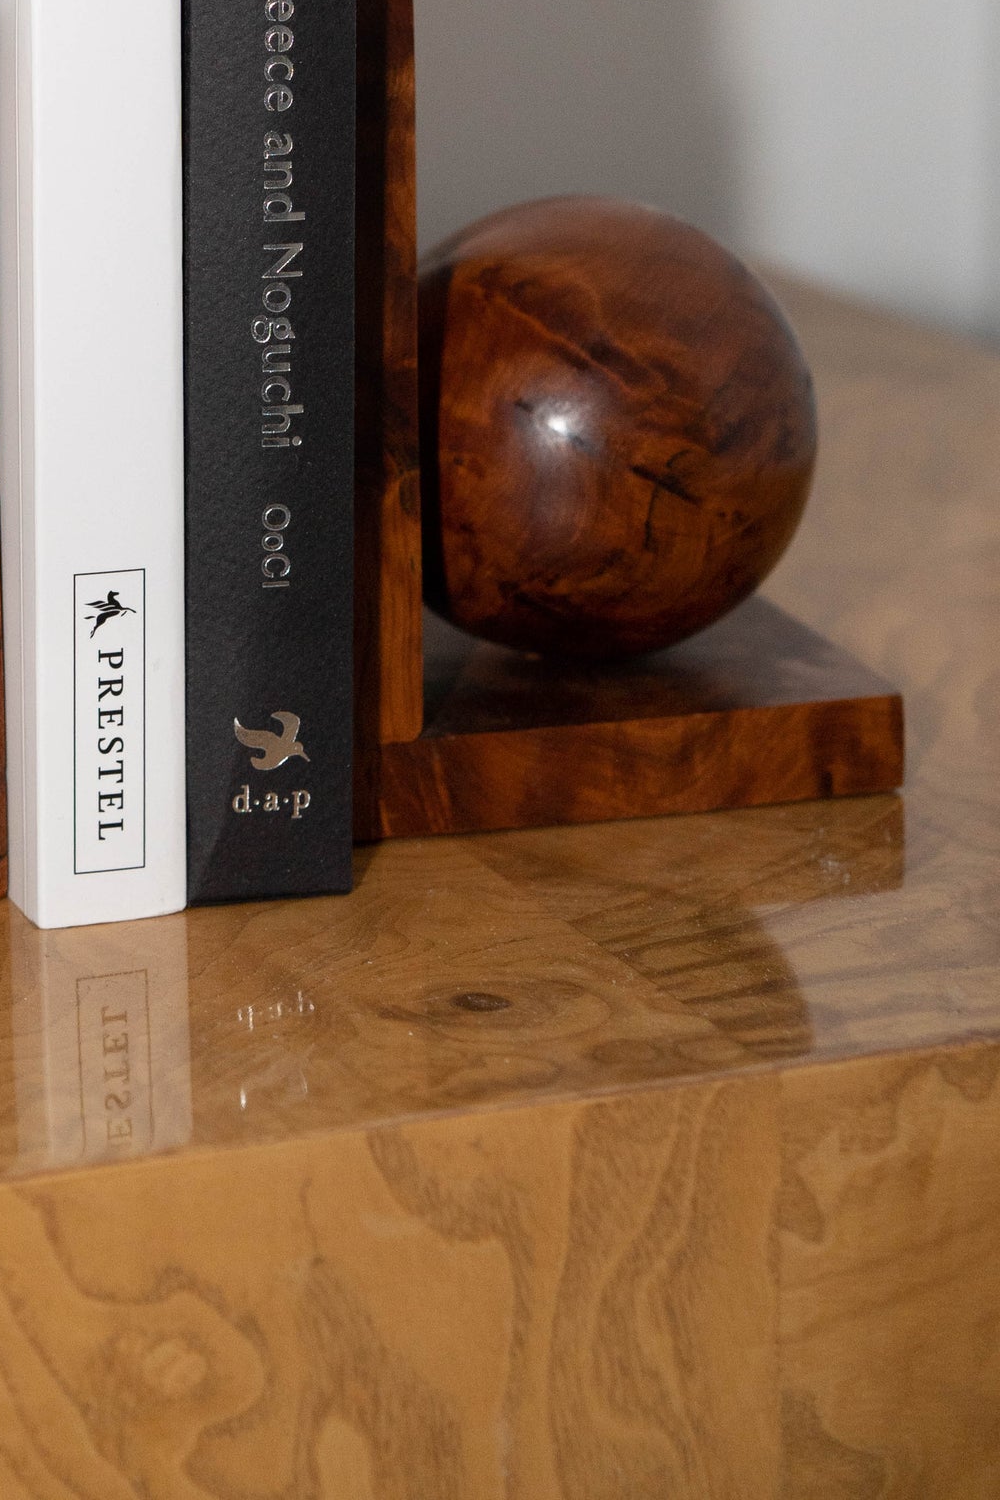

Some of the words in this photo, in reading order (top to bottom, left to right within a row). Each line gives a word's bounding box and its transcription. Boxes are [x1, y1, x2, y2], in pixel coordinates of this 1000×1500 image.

[263, 129, 307, 223] and
[250, 241, 305, 449] Noguchi
[97, 646, 126, 842] PRESTEL
